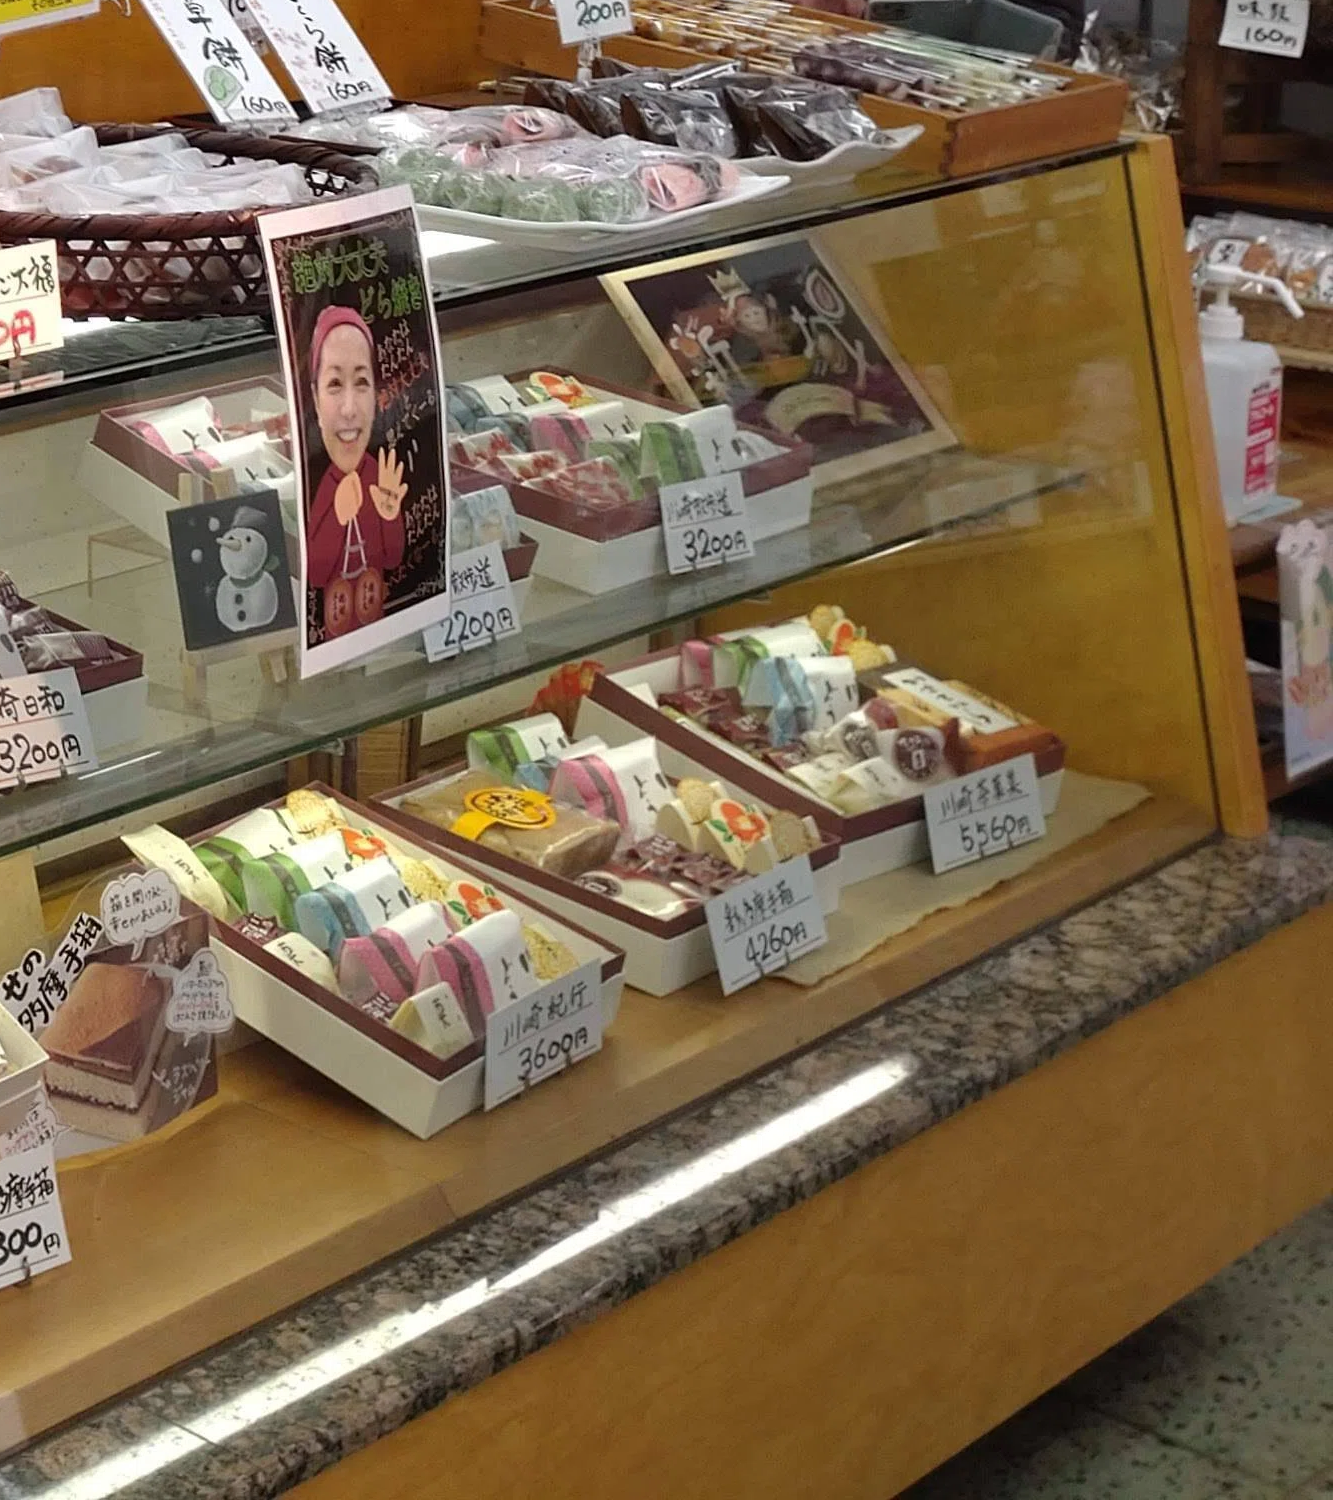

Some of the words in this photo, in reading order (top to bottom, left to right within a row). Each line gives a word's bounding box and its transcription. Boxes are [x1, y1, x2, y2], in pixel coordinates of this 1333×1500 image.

[576, 0, 626, 28] 200円
[241, 95, 289, 115] 160円
[328, 80, 373, 101] 160円
[439, 606, 514, 648] 2200円
[959, 815, 1032, 853] 5560円
[744, 921, 808, 964] 4260円
[503, 980, 588, 1047] 川崎紀行
[517, 1025, 589, 1082] 3600円
